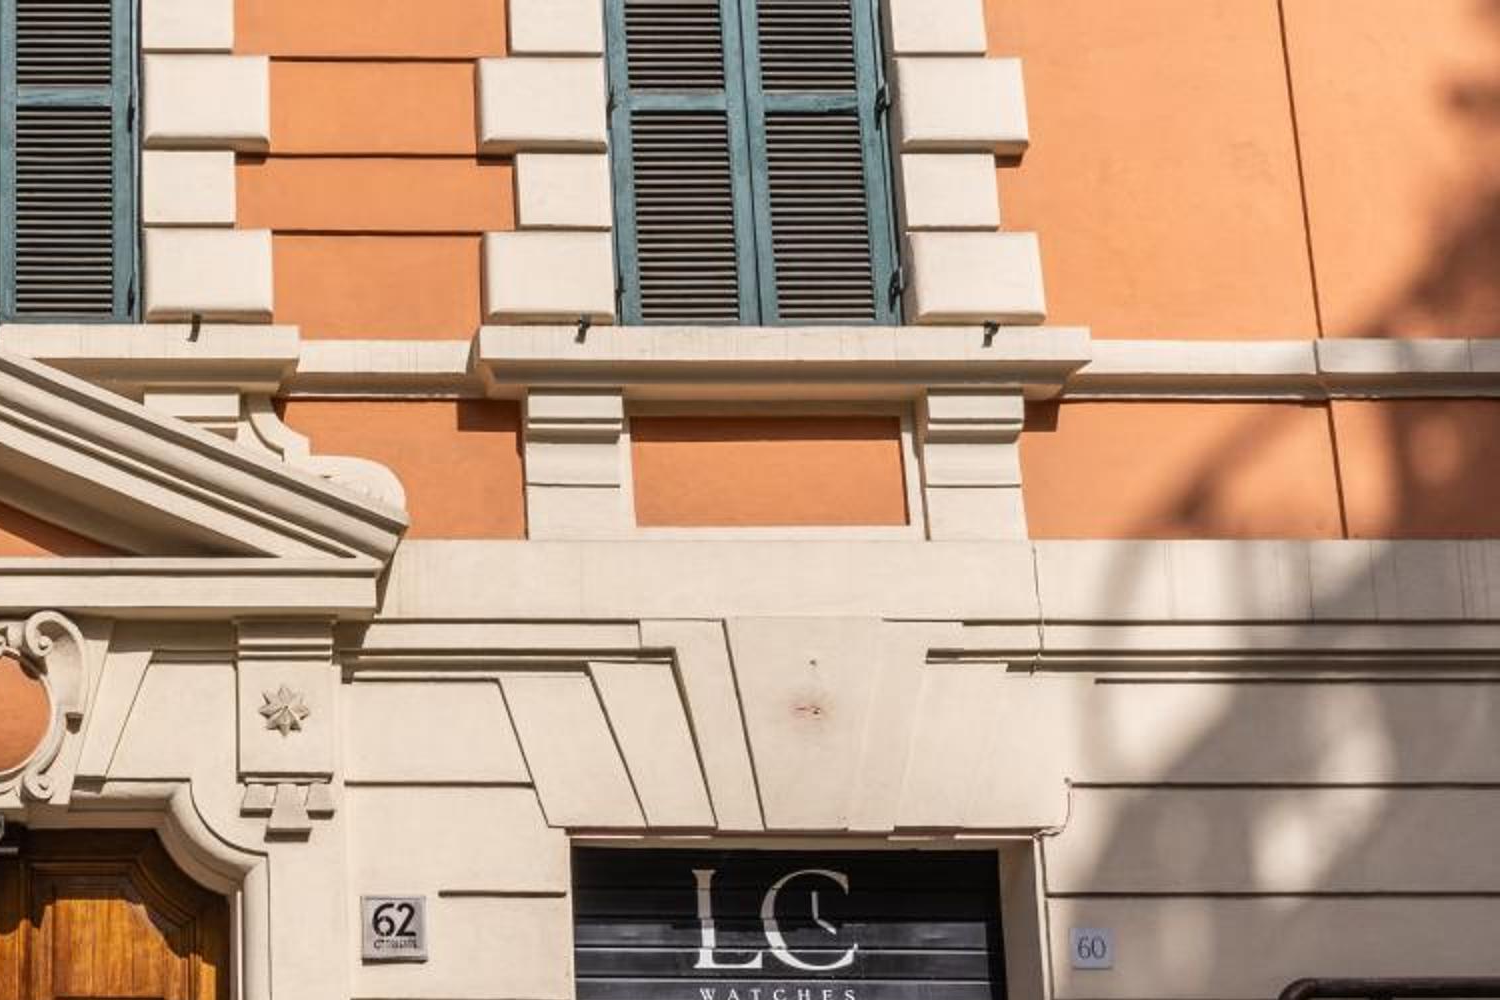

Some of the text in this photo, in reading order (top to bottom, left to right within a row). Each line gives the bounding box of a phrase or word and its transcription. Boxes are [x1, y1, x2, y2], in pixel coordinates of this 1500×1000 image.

[373, 902, 416, 937] 62
[692, 869, 860, 971] LC
[1077, 935, 1107, 960] 60
